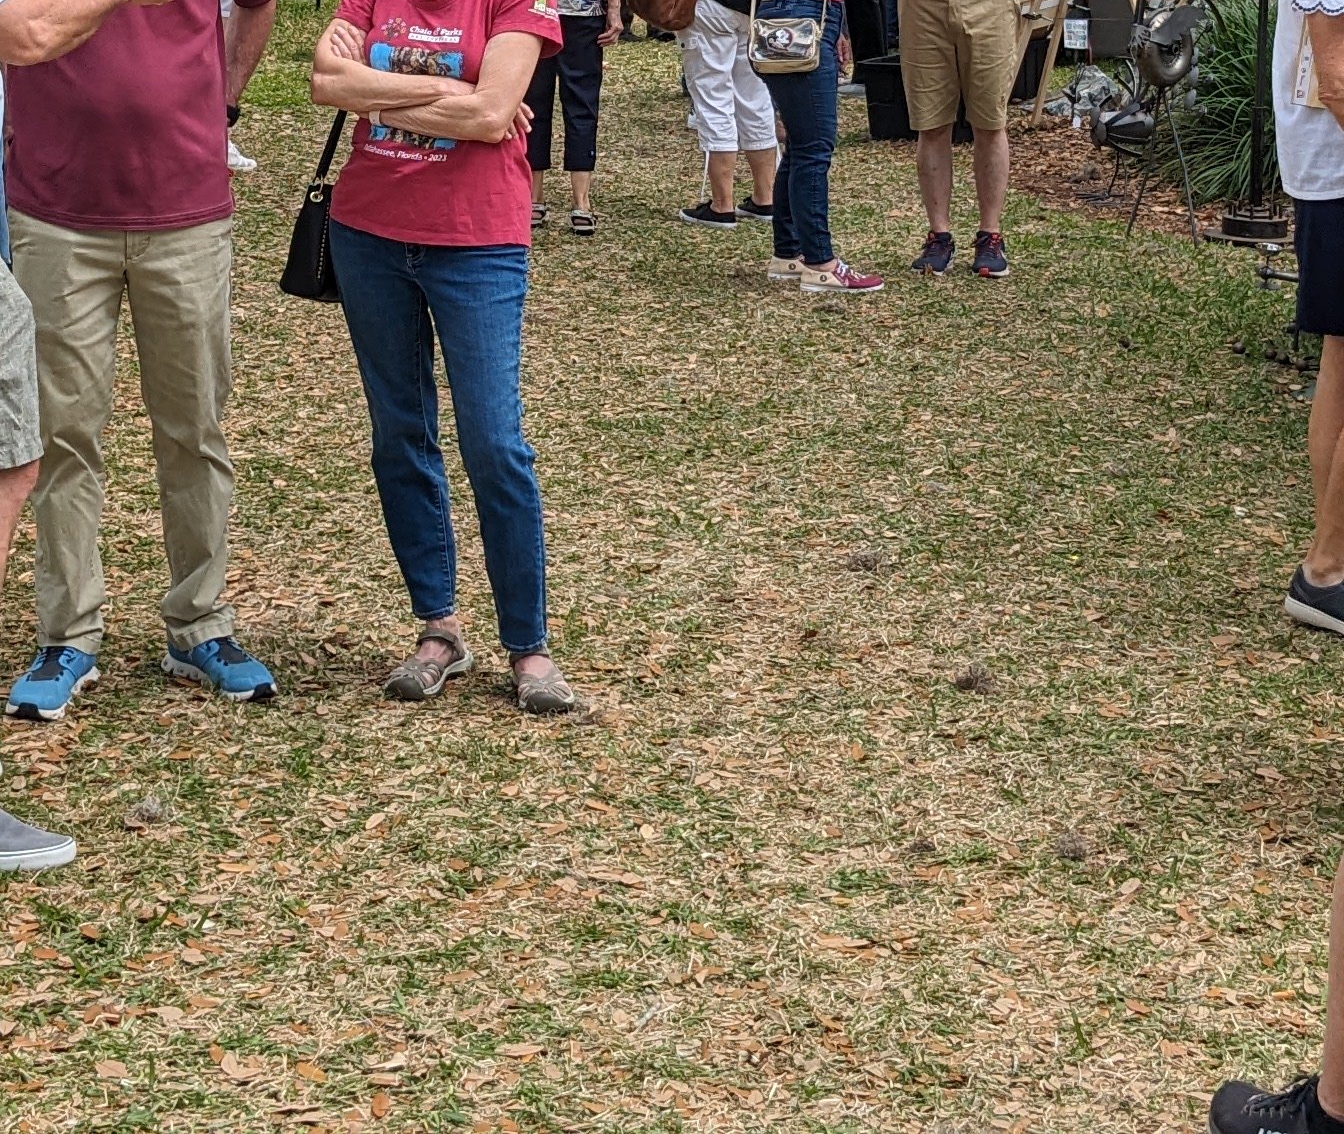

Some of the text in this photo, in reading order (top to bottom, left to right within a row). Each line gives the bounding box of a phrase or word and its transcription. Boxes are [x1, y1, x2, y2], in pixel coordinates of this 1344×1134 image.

[440, 27, 463, 36] Parks
[397, 150, 423, 161] Florida
[427, 154, 448, 162] 2023
